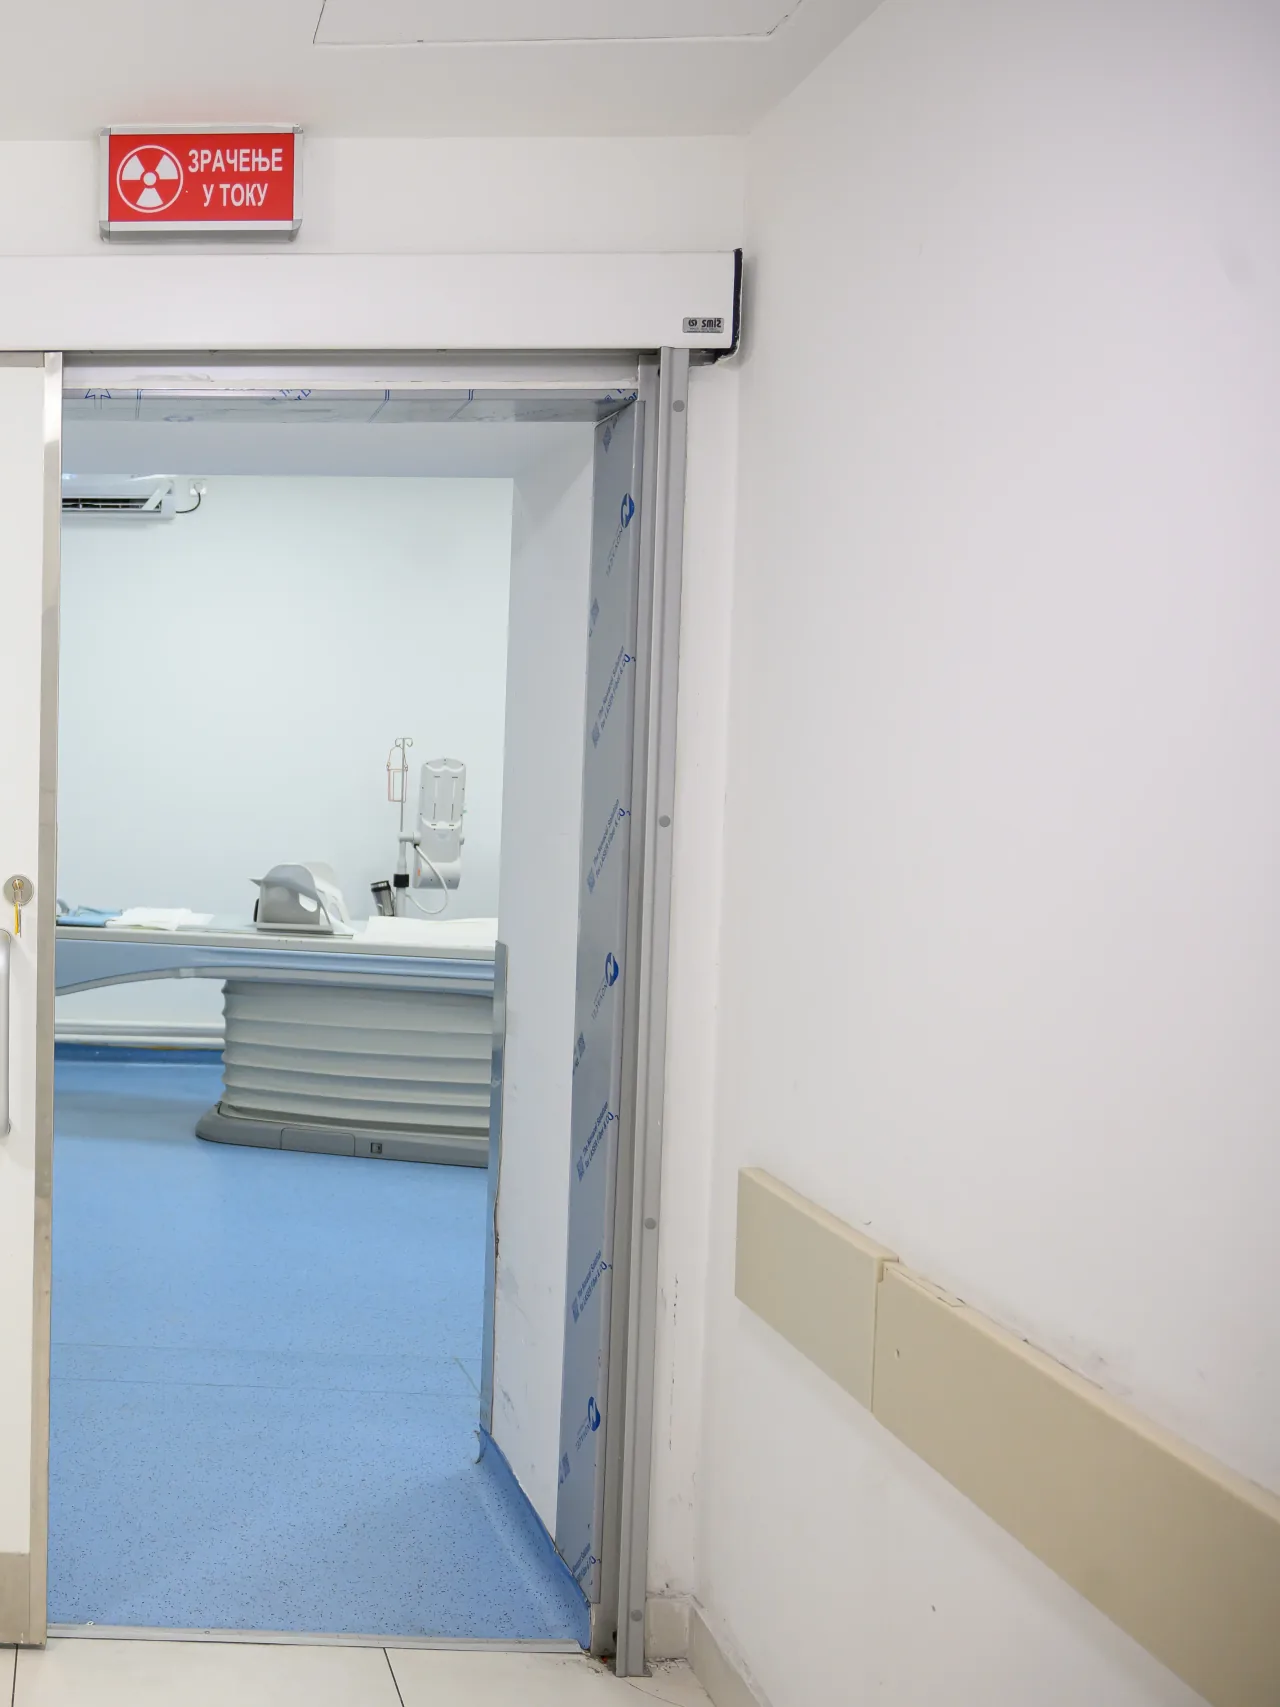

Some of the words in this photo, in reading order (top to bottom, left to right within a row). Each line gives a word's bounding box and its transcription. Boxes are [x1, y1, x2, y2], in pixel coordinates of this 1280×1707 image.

[188, 148, 283, 173] ЗРАЧЕЊЕ
[203, 184, 214, 207] У
[219, 183, 269, 207] ТОКУ
